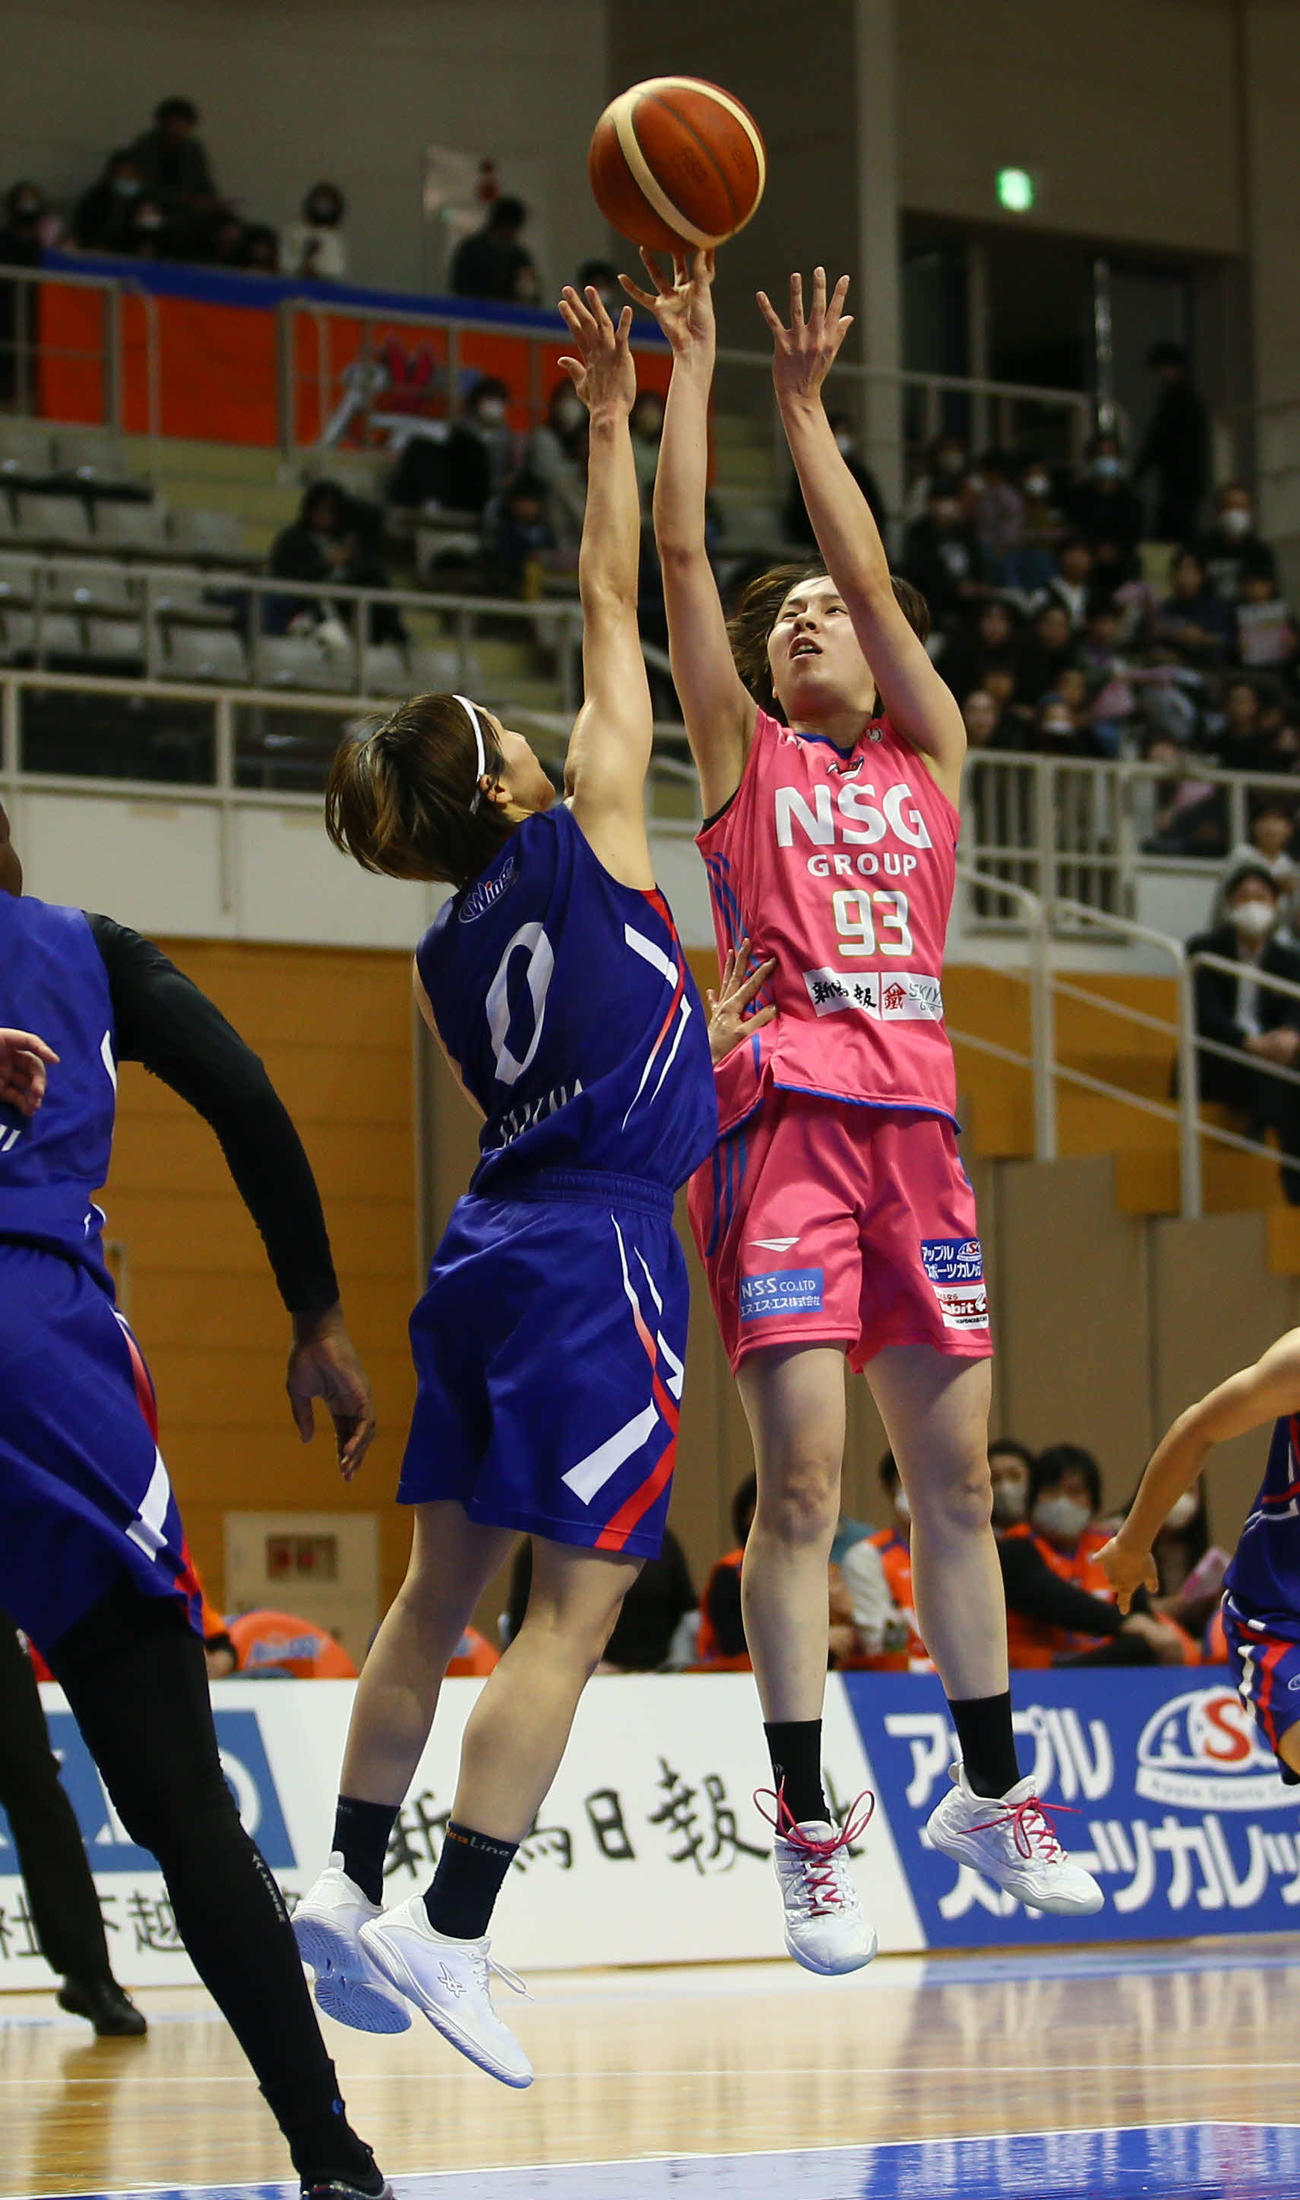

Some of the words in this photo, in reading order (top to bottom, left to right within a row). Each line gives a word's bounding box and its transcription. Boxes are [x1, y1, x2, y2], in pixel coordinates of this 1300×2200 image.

[775, 783, 932, 848] NSG
[807, 853, 917, 877] GROUP
[832, 889, 914, 957] 93
[486, 922, 554, 1086] 0
[884, 1705, 1113, 1808] アプル
